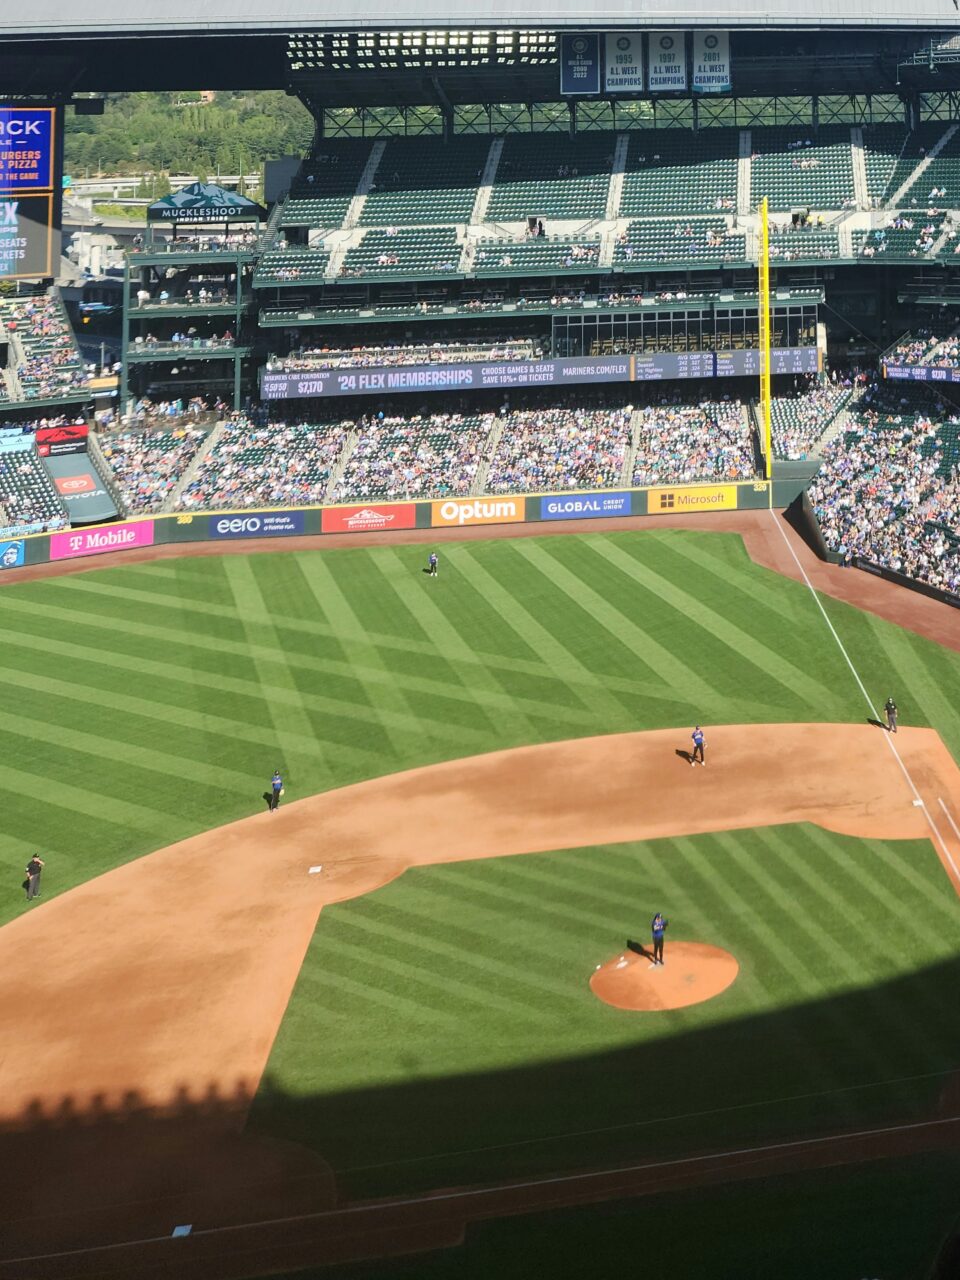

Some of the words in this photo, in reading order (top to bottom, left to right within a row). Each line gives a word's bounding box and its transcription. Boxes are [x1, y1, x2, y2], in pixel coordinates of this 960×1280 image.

[616, 55, 632, 64] 1995
[659, 53, 676, 63] 1997
[703, 52, 720, 62] 2001
[611, 67, 620, 75] A.L.
[622, 67, 637, 75] WEST
[654, 66, 664, 74] A.L.
[665, 66, 681, 74] WEST
[698, 65, 708, 73] A.L.
[607, 78, 641, 86] CHAMPIONS
[651, 76, 684, 85] CHAMPIONS
[695, 75, 729, 84] CHAMPIONS
[0, 151, 41, 160] URGERS
[8, 160, 38, 169] PIZZA
[20, 172, 39, 180] GAME
[162, 208, 244, 217] MUCKLESHOOT
[0, 238, 27, 248] SEATS
[481, 366, 506, 376] CHOOSE
[507, 365, 529, 374] GAMES
[530, 365, 534, 373] &
[535, 364, 555, 373] SEATS
[562, 365, 627, 376] MARINERS.COM/FLEX
[301, 372, 330, 380] FOUNDATION
[359, 374, 385, 389] FLEX
[388, 369, 473, 388] MEMBERSHIPS
[482, 375, 498, 384] SAVE
[518, 374, 527, 382] ON
[528, 373, 554, 381] TICKETS
[298, 381, 323, 394] $7,170
[677, 493, 724, 505] Microsoft
[548, 501, 600, 513] GLOBAL
[441, 501, 516, 524] Optum
[217, 518, 261, 534] eero
[70, 536, 83, 551] T
[86, 529, 136, 548] Mobile
